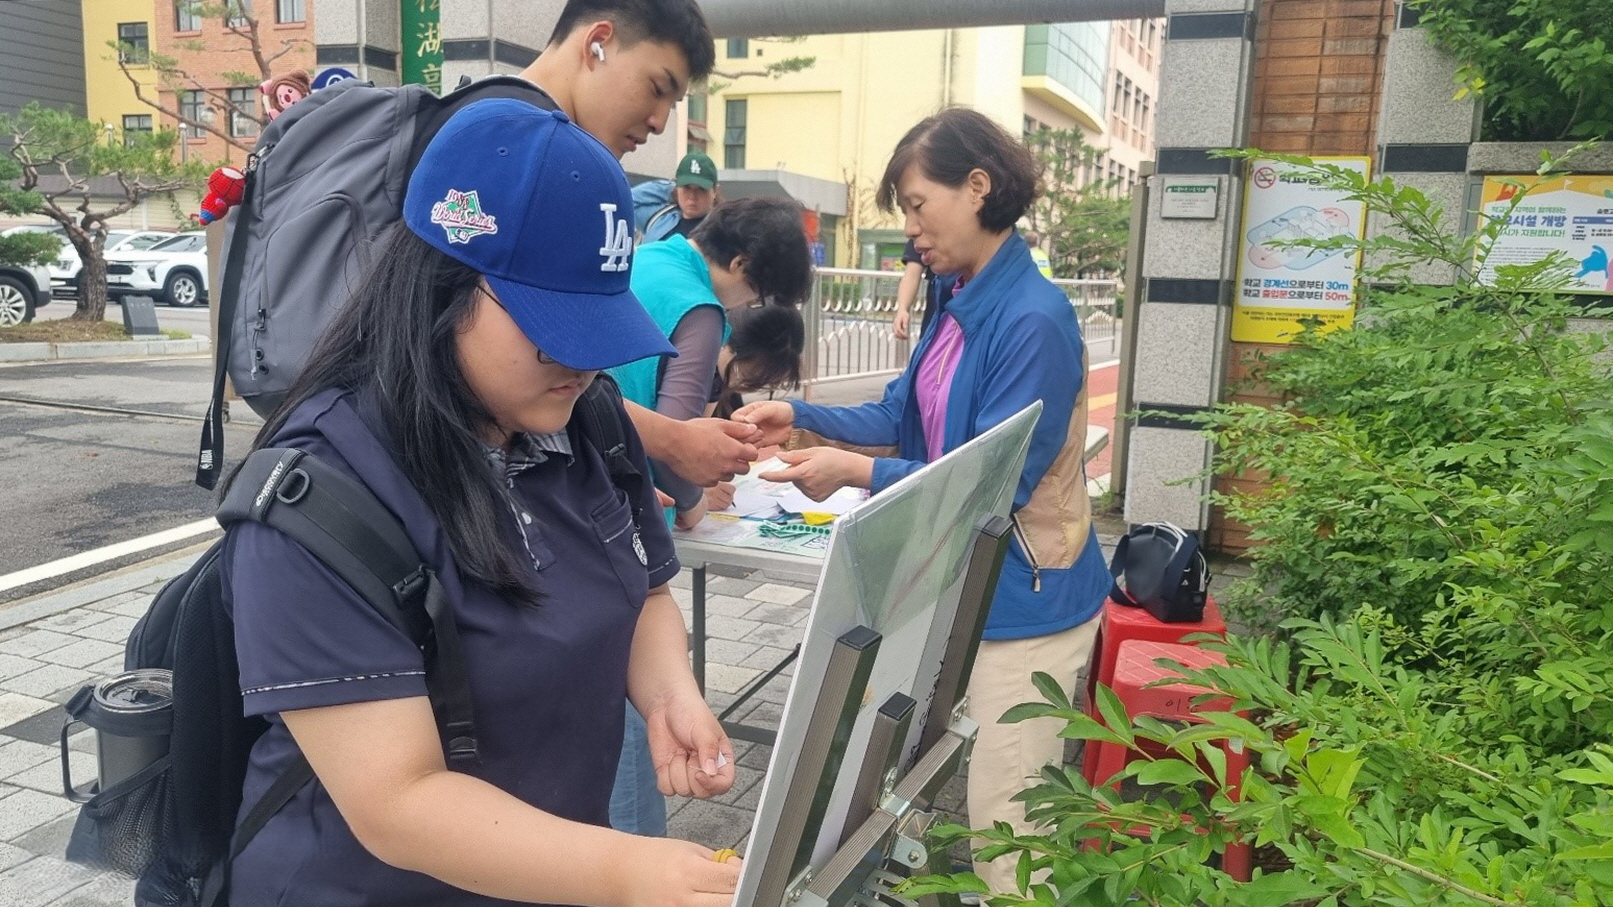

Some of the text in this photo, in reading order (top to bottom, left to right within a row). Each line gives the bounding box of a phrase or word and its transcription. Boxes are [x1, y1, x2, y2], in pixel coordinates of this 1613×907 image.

[433, 203, 495, 227] World Series
[1541, 214, 1567, 228] 개방
[600, 203, 632, 272] LA
[1243, 278, 1349, 290] 학교 경계선으로부터 30m
[1243, 288, 1348, 301] 학교 출입문으로부터 50m
